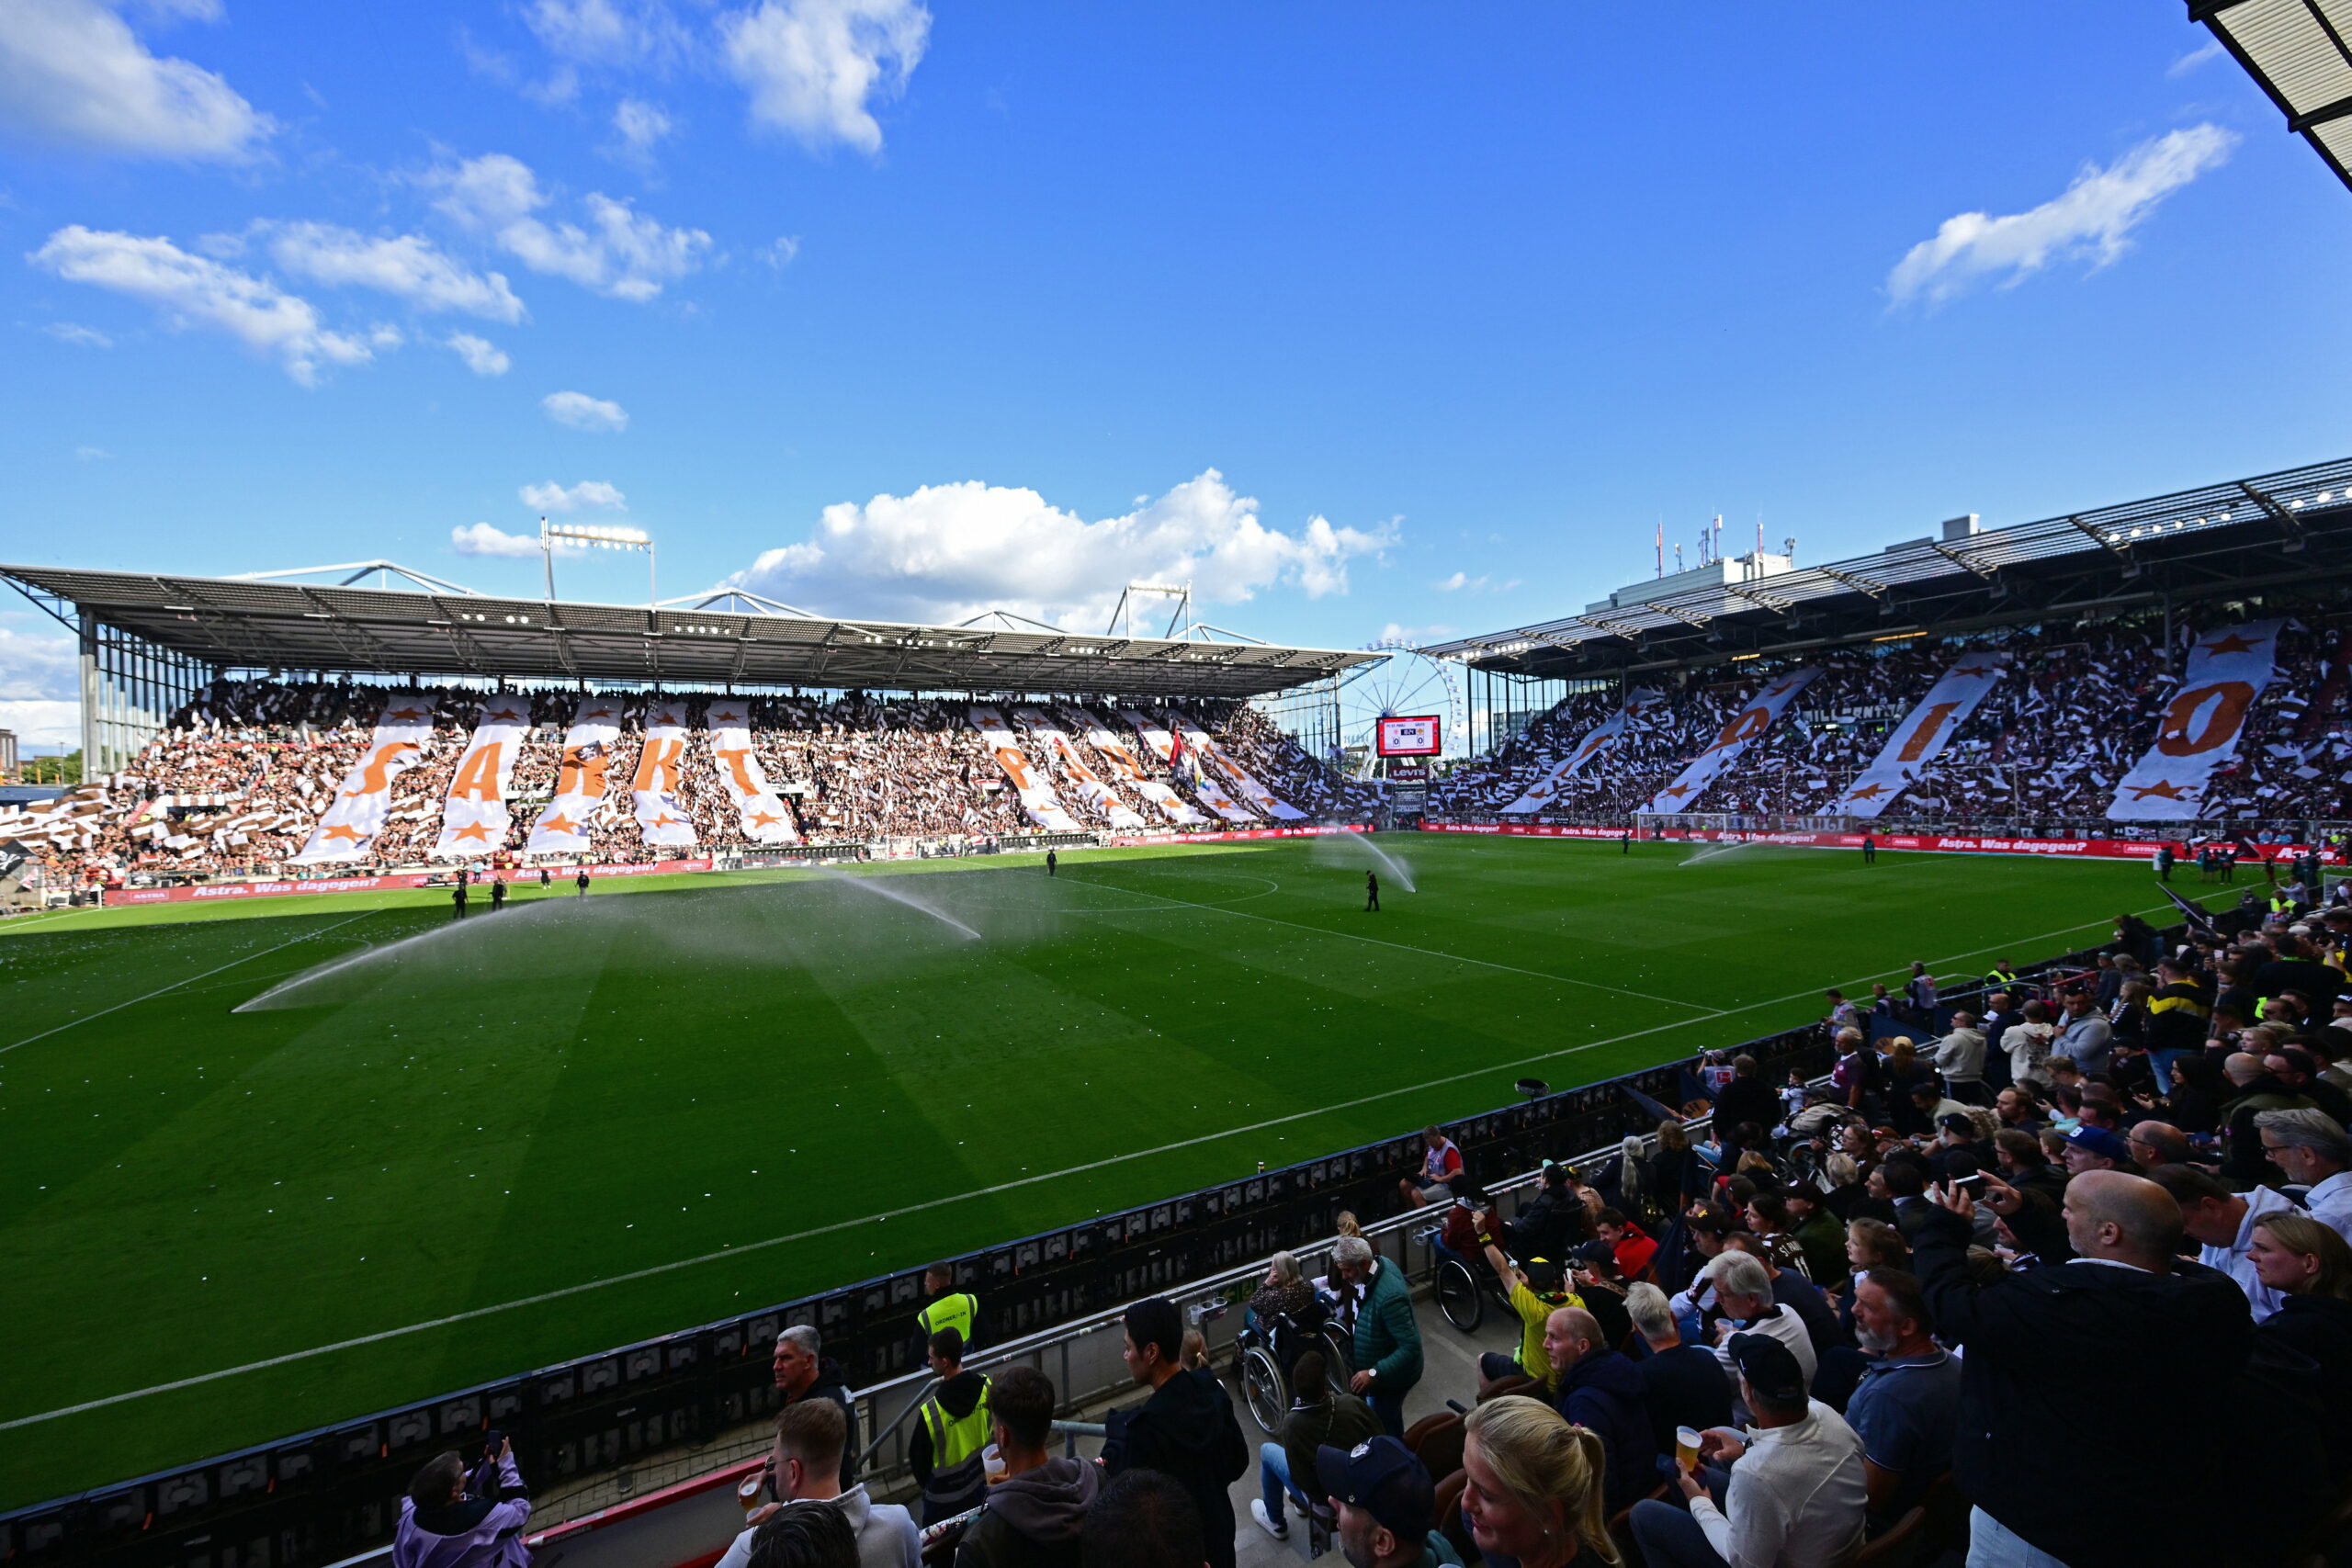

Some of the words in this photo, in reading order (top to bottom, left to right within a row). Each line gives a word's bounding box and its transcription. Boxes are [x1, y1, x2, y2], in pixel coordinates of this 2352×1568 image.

[1768, 833, 1816, 843] dagegen?
[1939, 839, 1977, 850] Astra.
[1981, 840, 2010, 850] Was
[2013, 840, 2086, 853] dagegen?
[560, 866, 590, 876] Was
[594, 863, 658, 874] dagegen?
[192, 886, 249, 897] Astra.
[254, 882, 292, 893] Was
[296, 877, 381, 892] dagegen?
[2069, 1126, 2084, 1138] B
[934, 1311, 967, 1326] ORDNER/-IN
